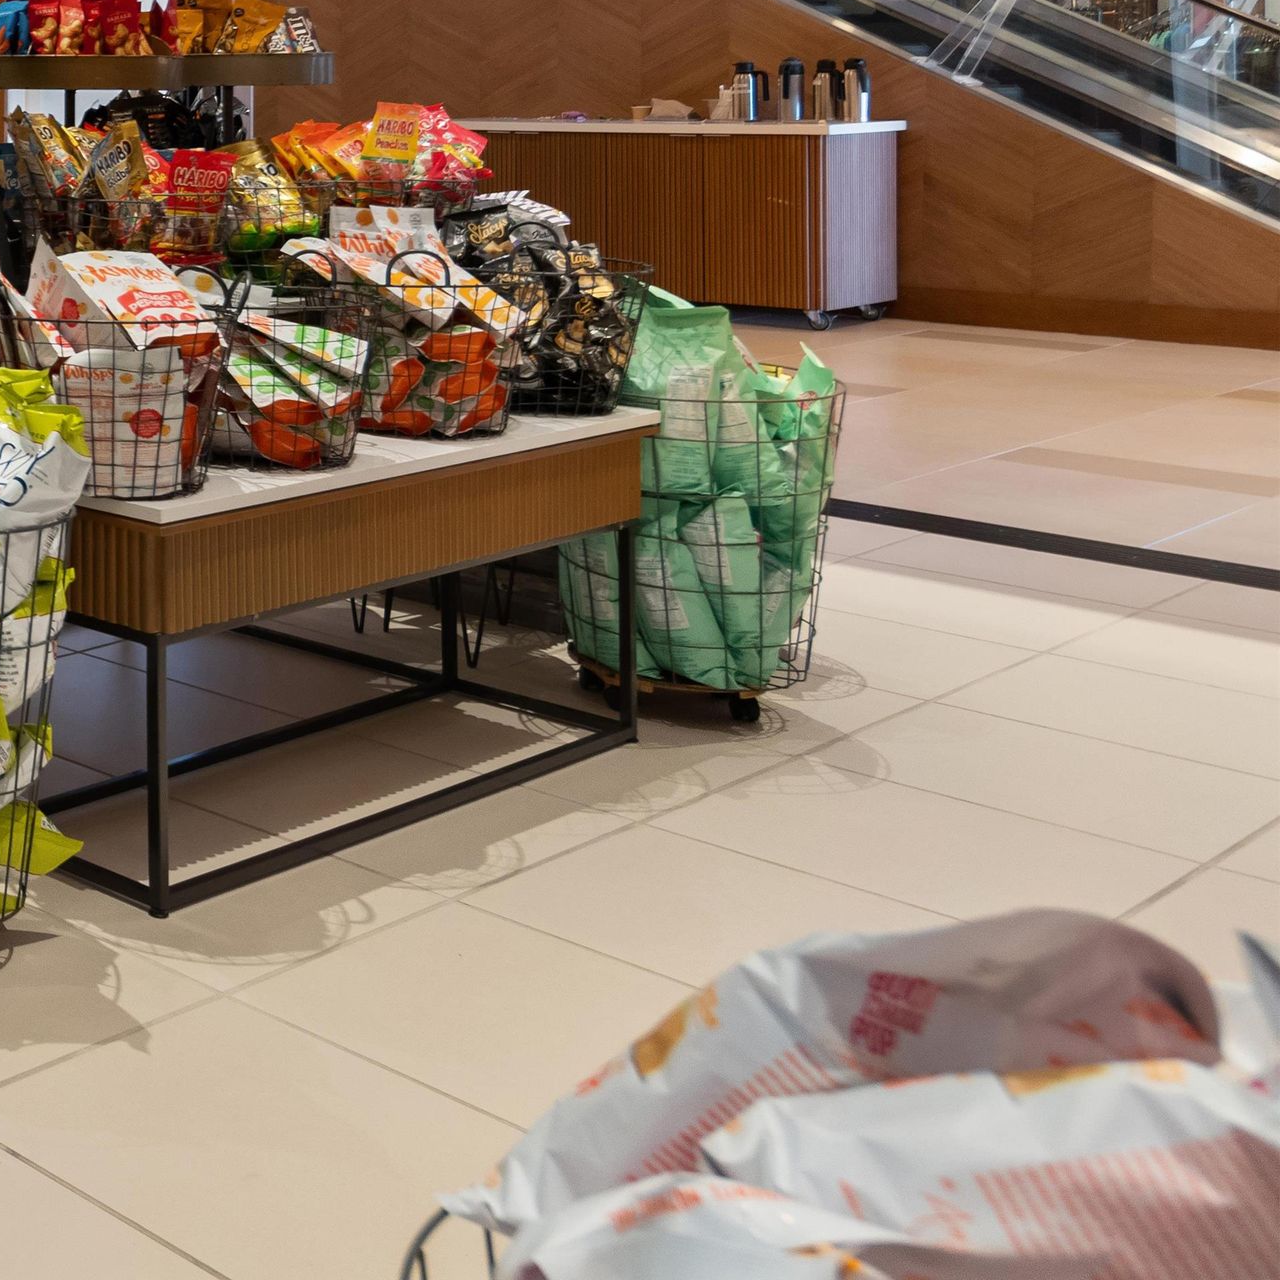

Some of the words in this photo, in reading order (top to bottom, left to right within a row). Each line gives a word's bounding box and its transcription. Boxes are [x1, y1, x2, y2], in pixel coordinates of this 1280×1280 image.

[376, 119, 416, 137] HARIBO
[96, 140, 132, 178] HARIBO
[173, 166, 229, 190] HARIBO
